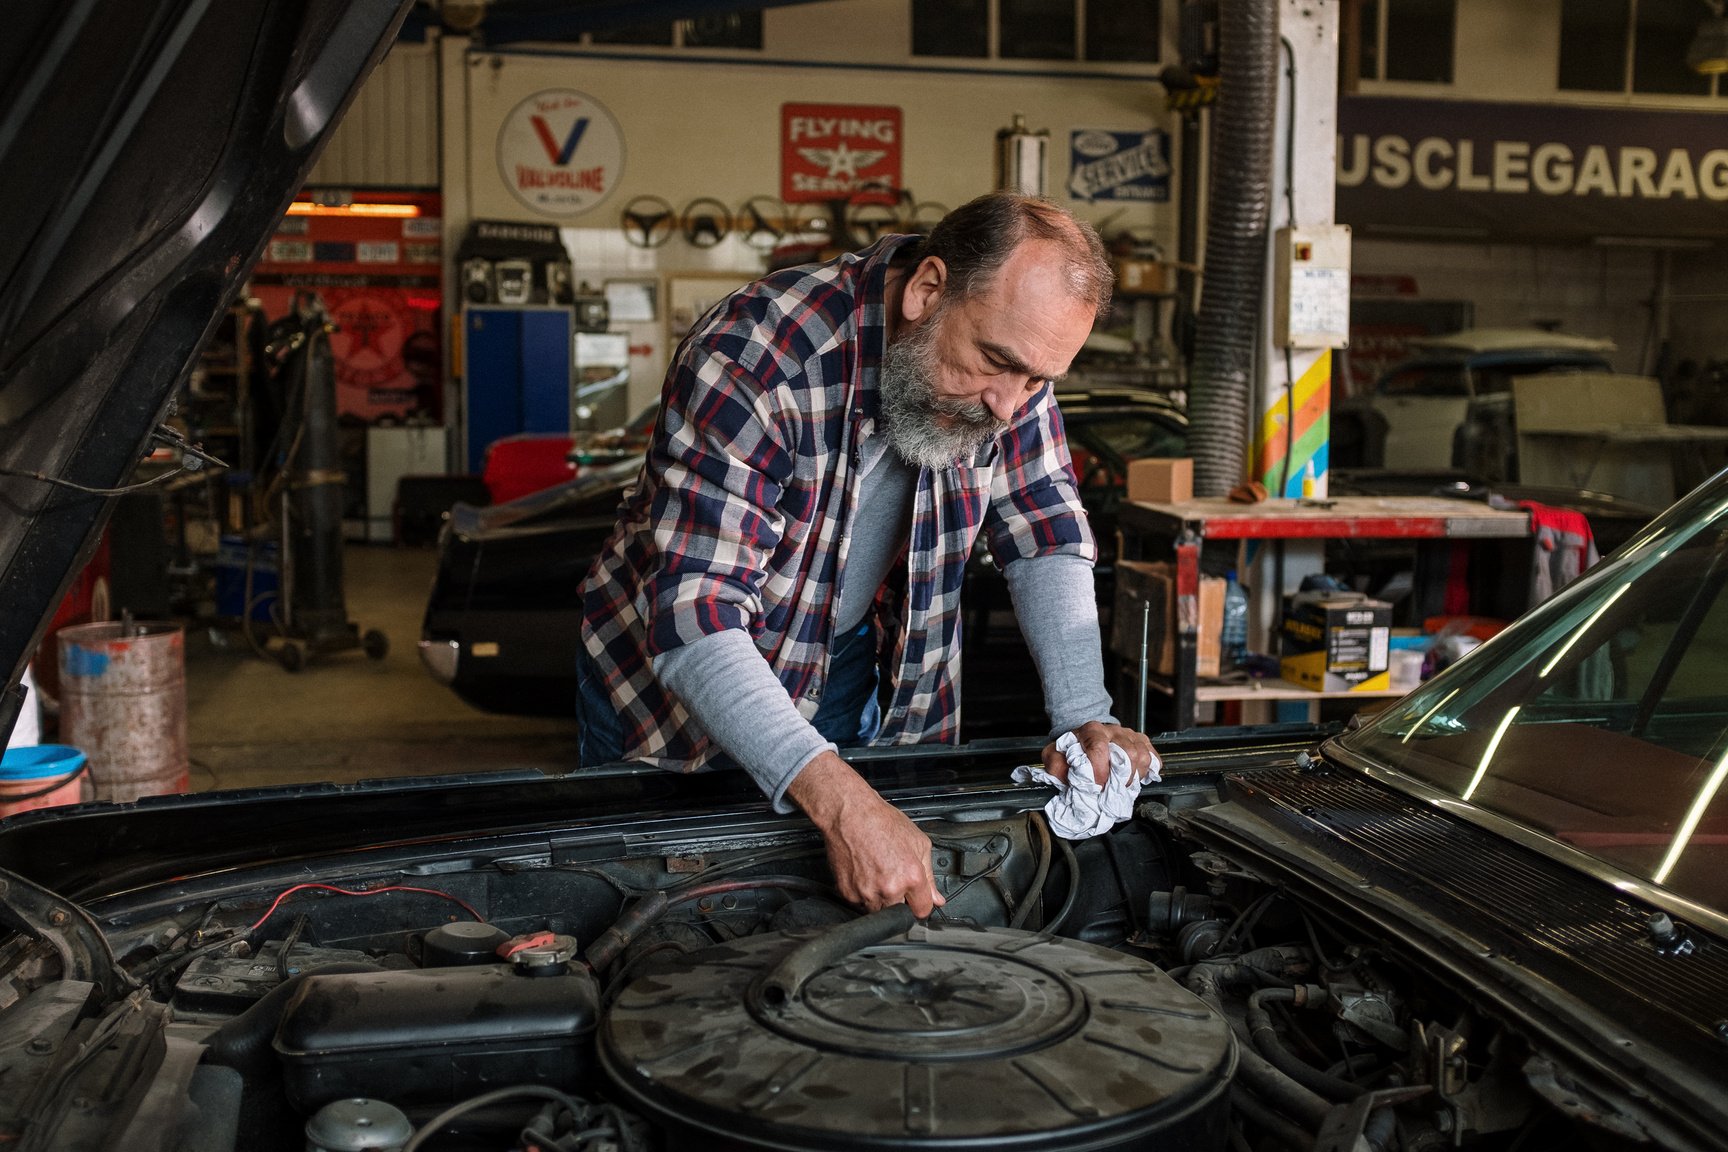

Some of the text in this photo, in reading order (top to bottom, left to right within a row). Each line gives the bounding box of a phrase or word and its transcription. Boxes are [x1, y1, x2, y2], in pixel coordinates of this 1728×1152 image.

[790, 116, 895, 143] FLYING
[515, 163, 605, 194] VALVOLINE
[1082, 140, 1161, 194] SERVICE
